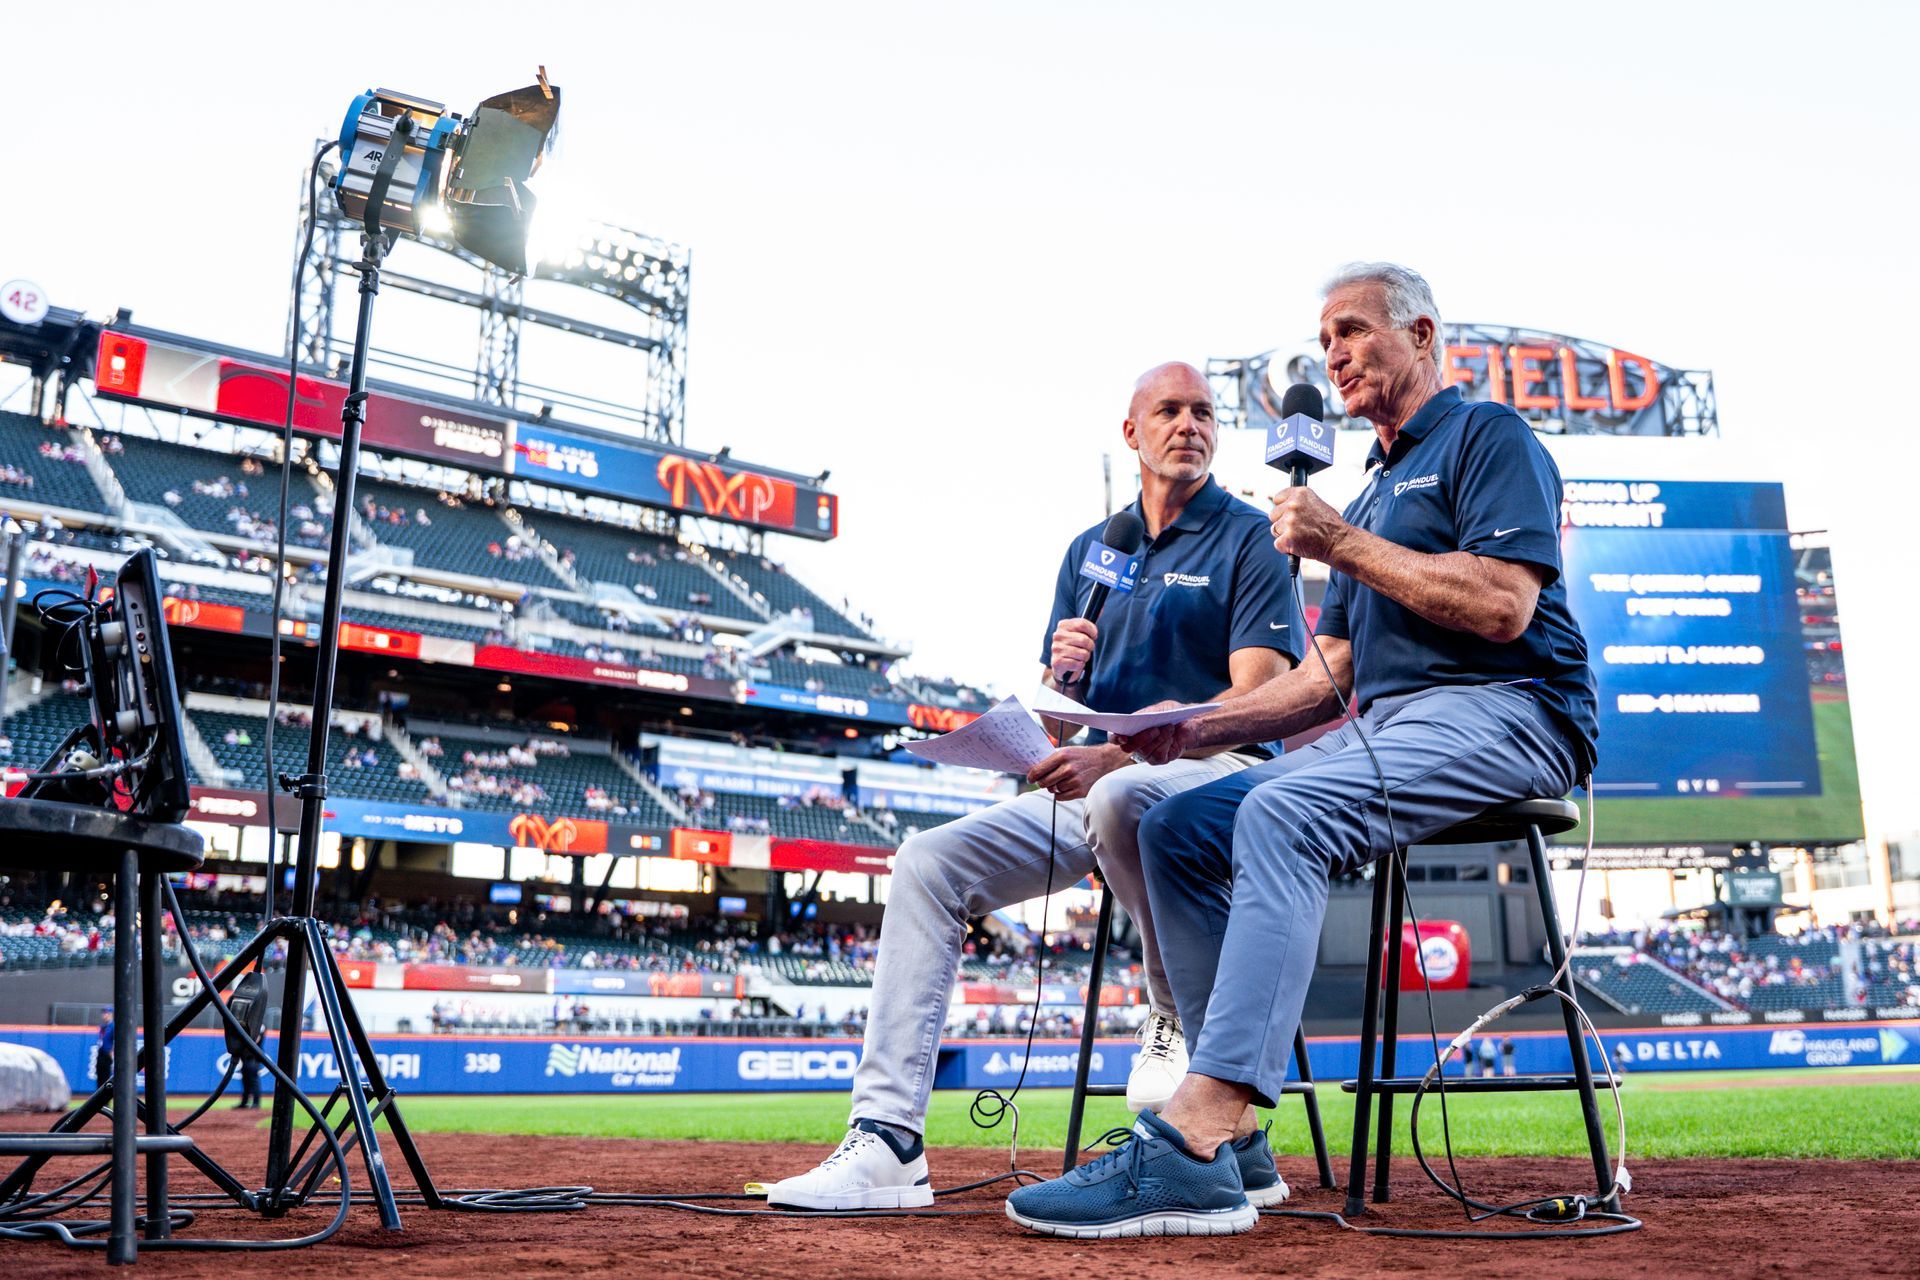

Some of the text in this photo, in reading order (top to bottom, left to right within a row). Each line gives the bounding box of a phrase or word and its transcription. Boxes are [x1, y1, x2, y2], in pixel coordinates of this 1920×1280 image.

[9, 290, 38, 312] 42
[1442, 344, 1661, 411] FIELD
[1300, 436, 1332, 456] FANDUEL
[1085, 561, 1118, 581] FANDUEL
[577, 1046, 682, 1073] National
[1636, 1041, 1722, 1061] DELTA
[463, 1053, 501, 1073] 358
[738, 1050, 858, 1080] GEICO
